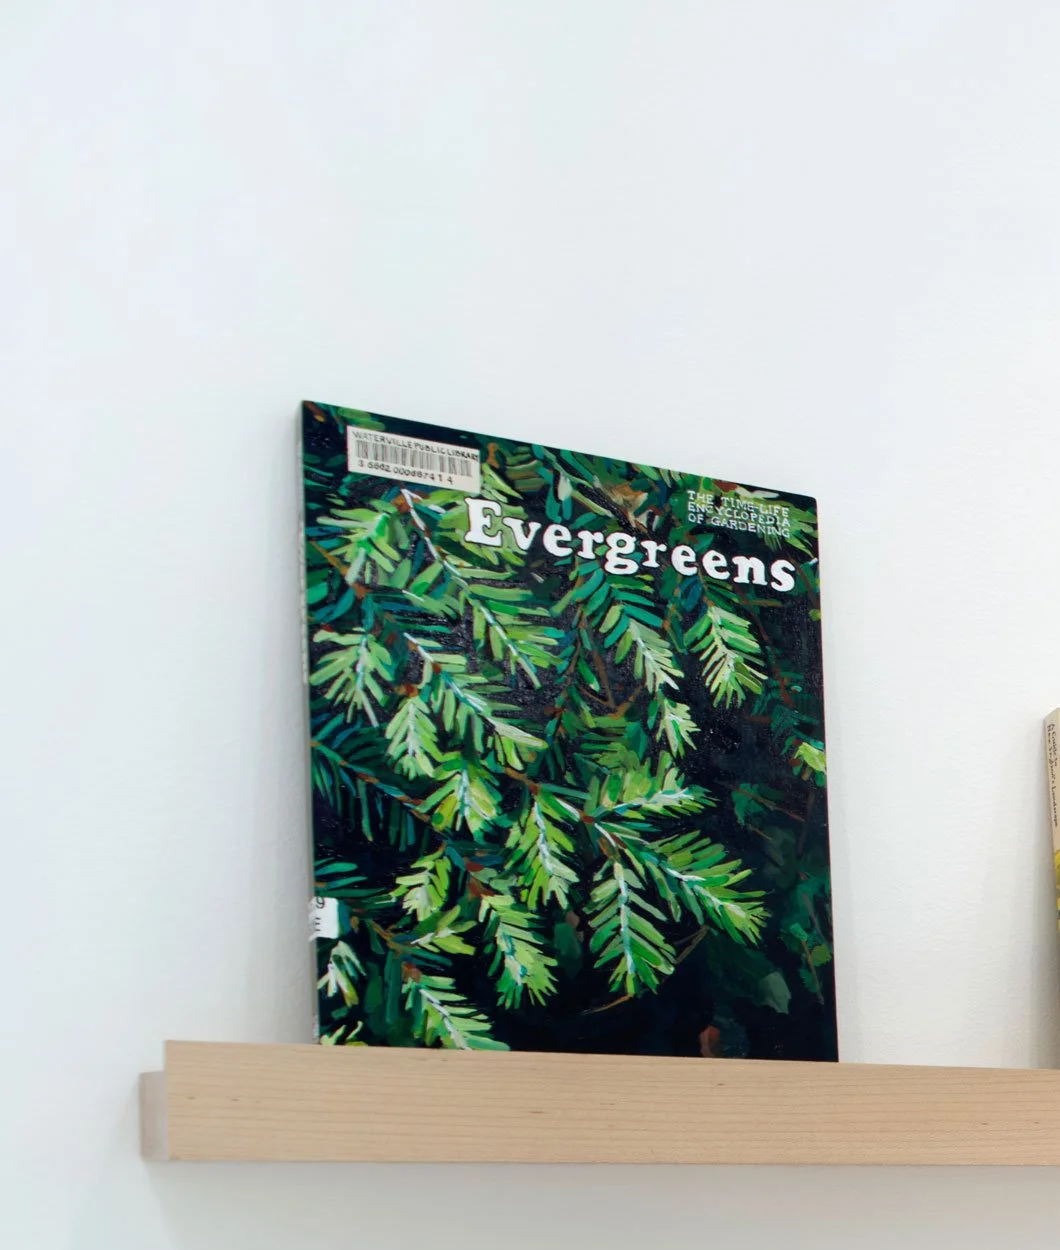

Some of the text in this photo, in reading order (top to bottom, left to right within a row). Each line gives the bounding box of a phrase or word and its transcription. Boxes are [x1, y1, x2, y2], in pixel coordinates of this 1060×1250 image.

[352, 431, 478, 461] WATERVILLE PUBLIC LIBRARY
[687, 490, 790, 517] THE TIME-LIFE
[687, 501, 791, 527] ENCYCLOPEDIA
[687, 513, 791, 538] OF GARDENING
[464, 497, 796, 592] Evergreens
